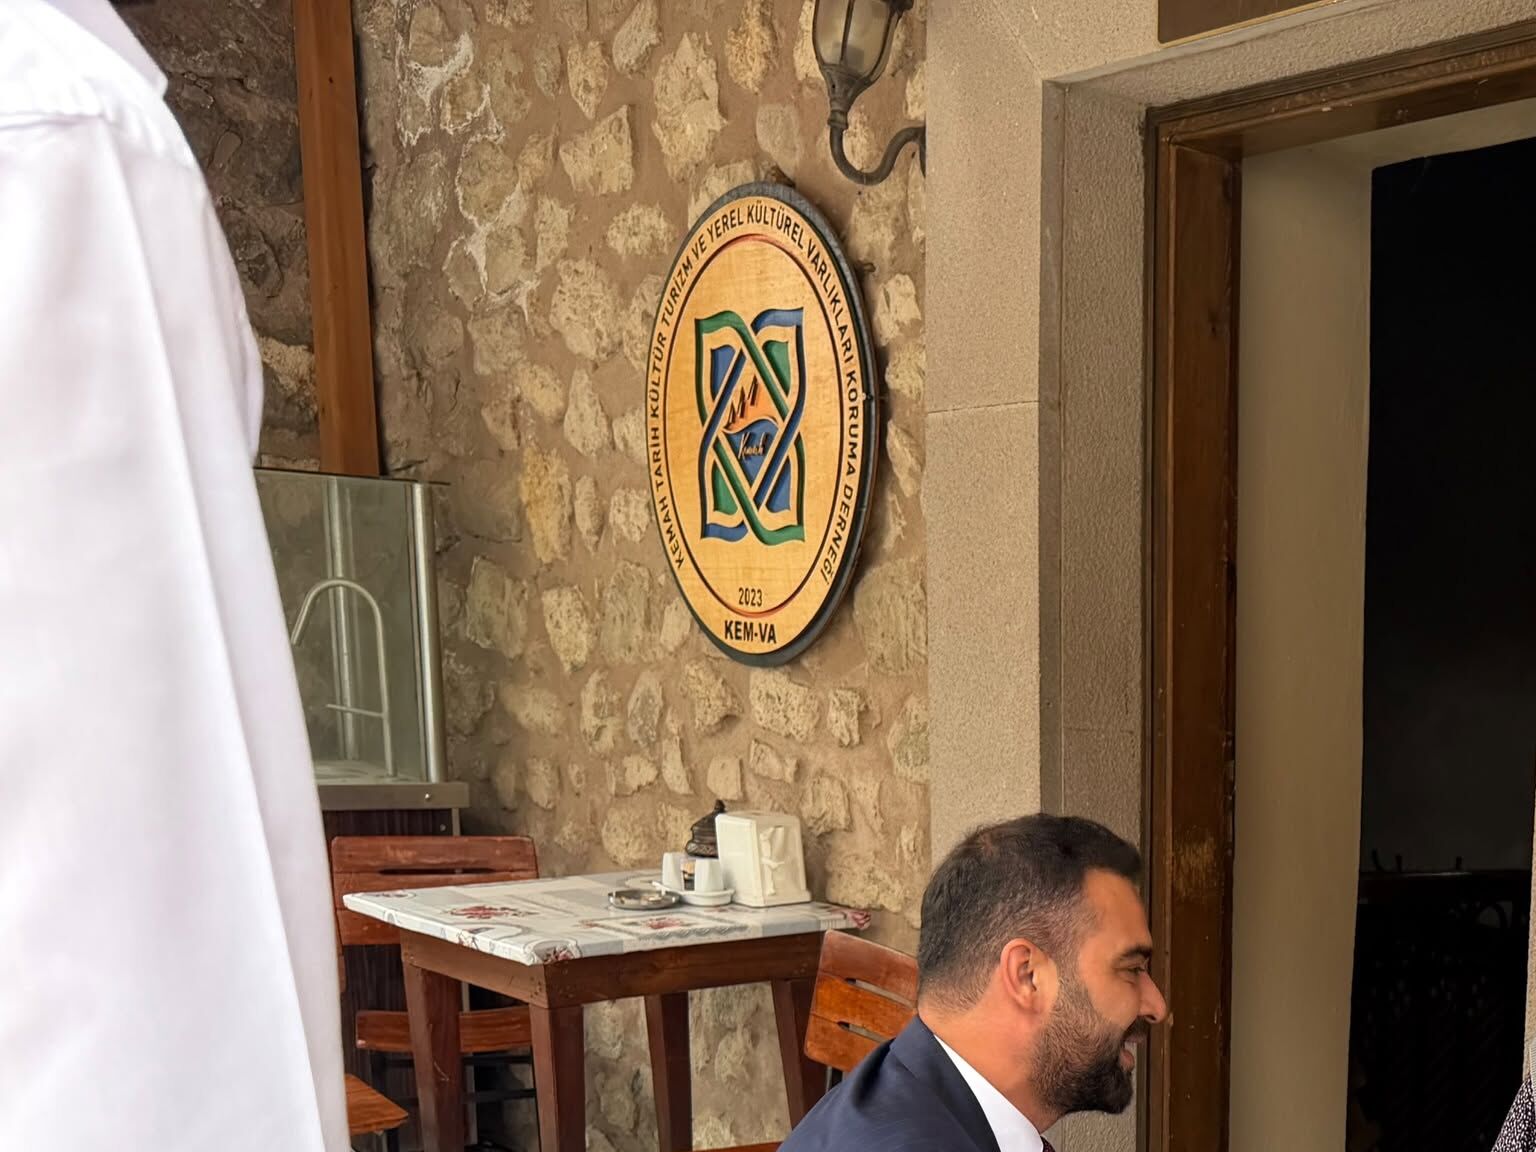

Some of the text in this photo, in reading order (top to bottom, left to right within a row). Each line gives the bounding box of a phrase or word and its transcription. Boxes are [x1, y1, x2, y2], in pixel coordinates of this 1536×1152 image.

[649, 200, 860, 586] KEMAH TARİH KÜLTÜR TURİZM VE YEREL KÜLTÜREL VARLIKLARI KORUMA DERNEĞİ
[738, 587, 763, 607] 2023
